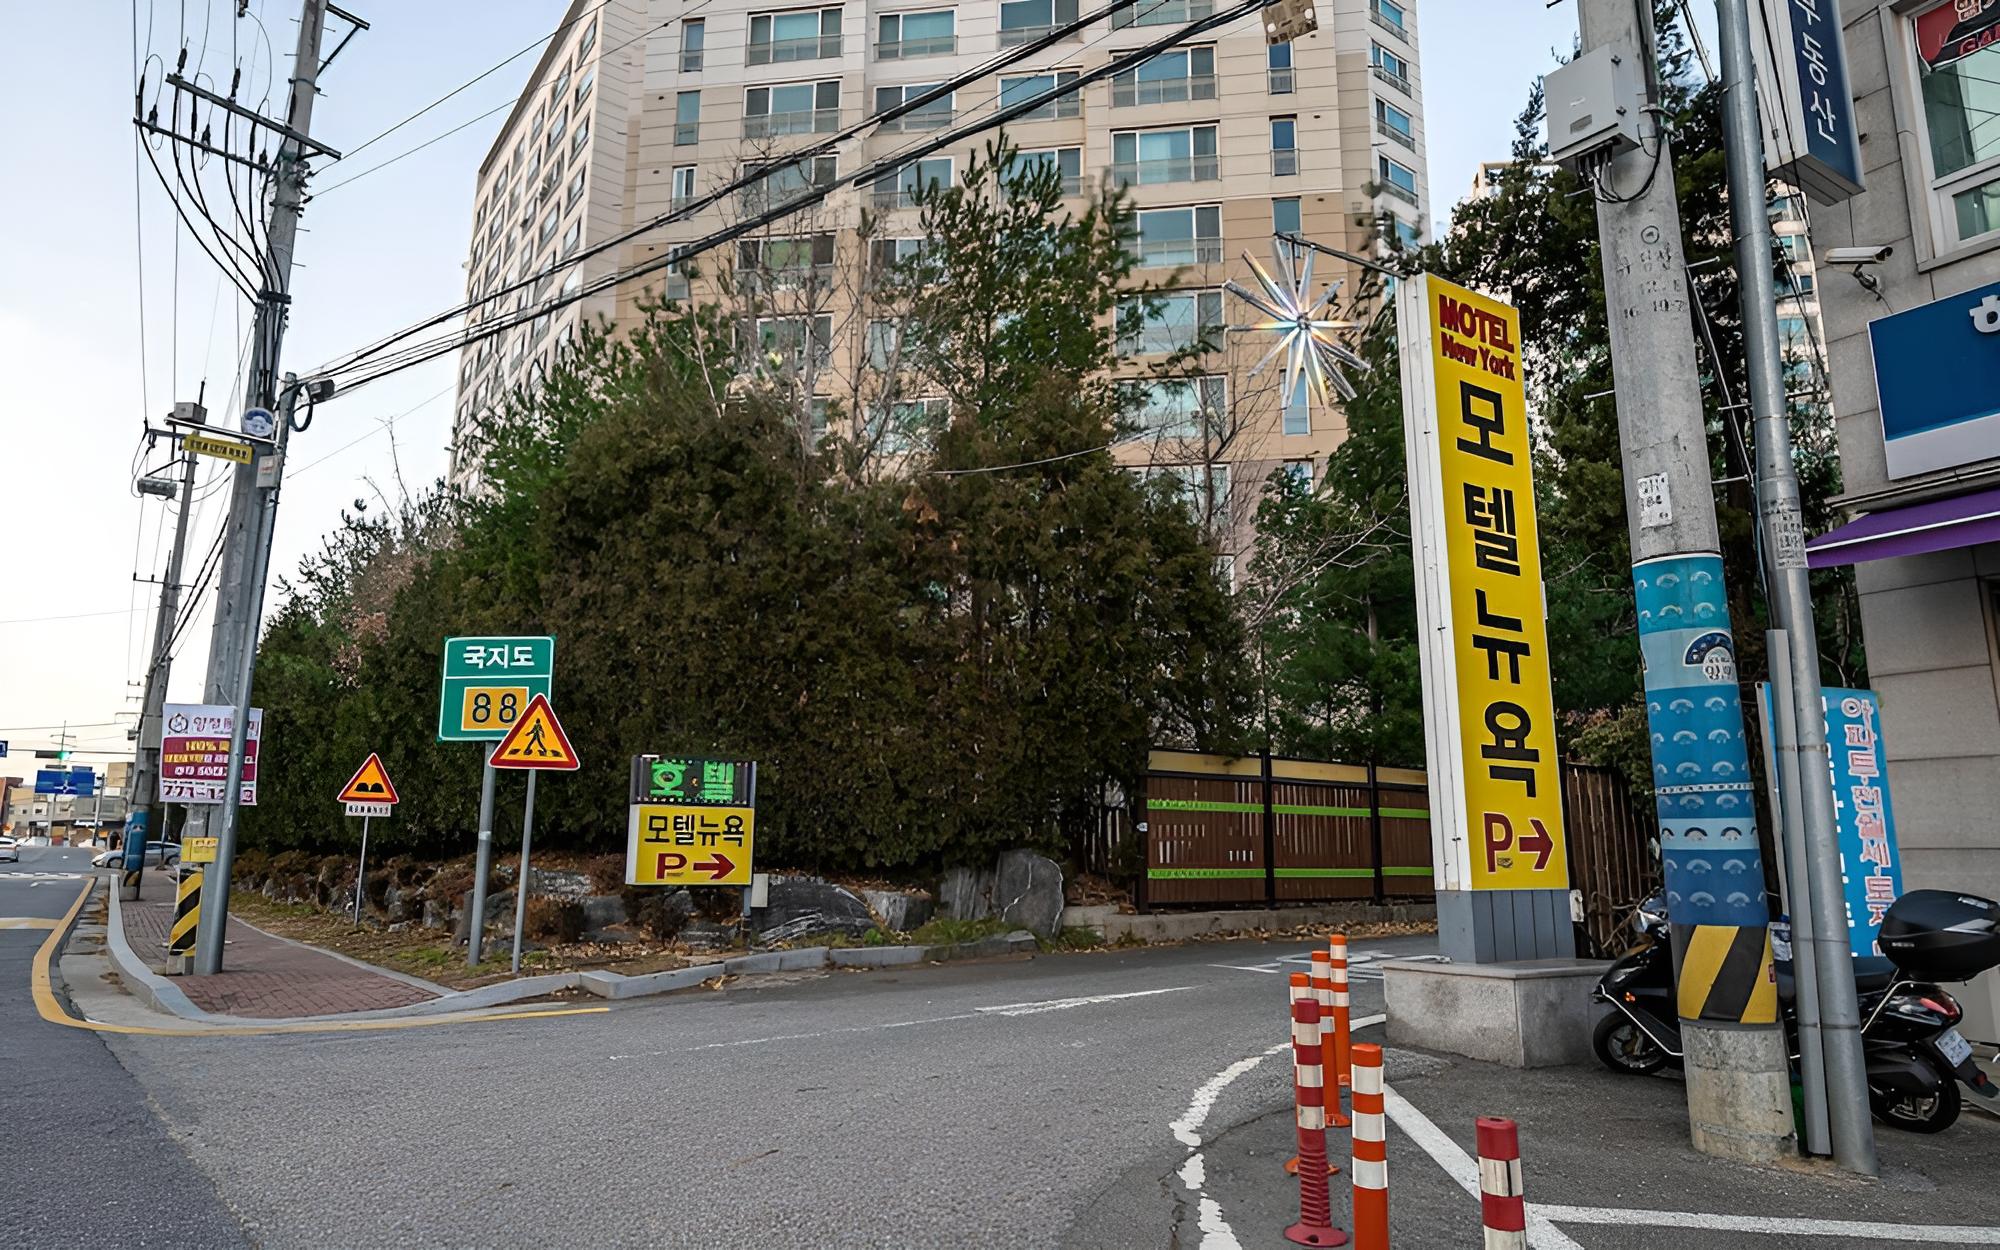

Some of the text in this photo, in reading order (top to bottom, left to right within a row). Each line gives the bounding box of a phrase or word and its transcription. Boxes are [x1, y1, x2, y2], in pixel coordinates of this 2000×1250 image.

[1439, 294, 1515, 354] MOTEL
[1441, 331, 1516, 382] New York
[462, 644, 535, 669] 국지도
[644, 814, 745, 848] 모텔뉴욕
[1483, 811, 1515, 875] P
[655, 852, 688, 880] P
